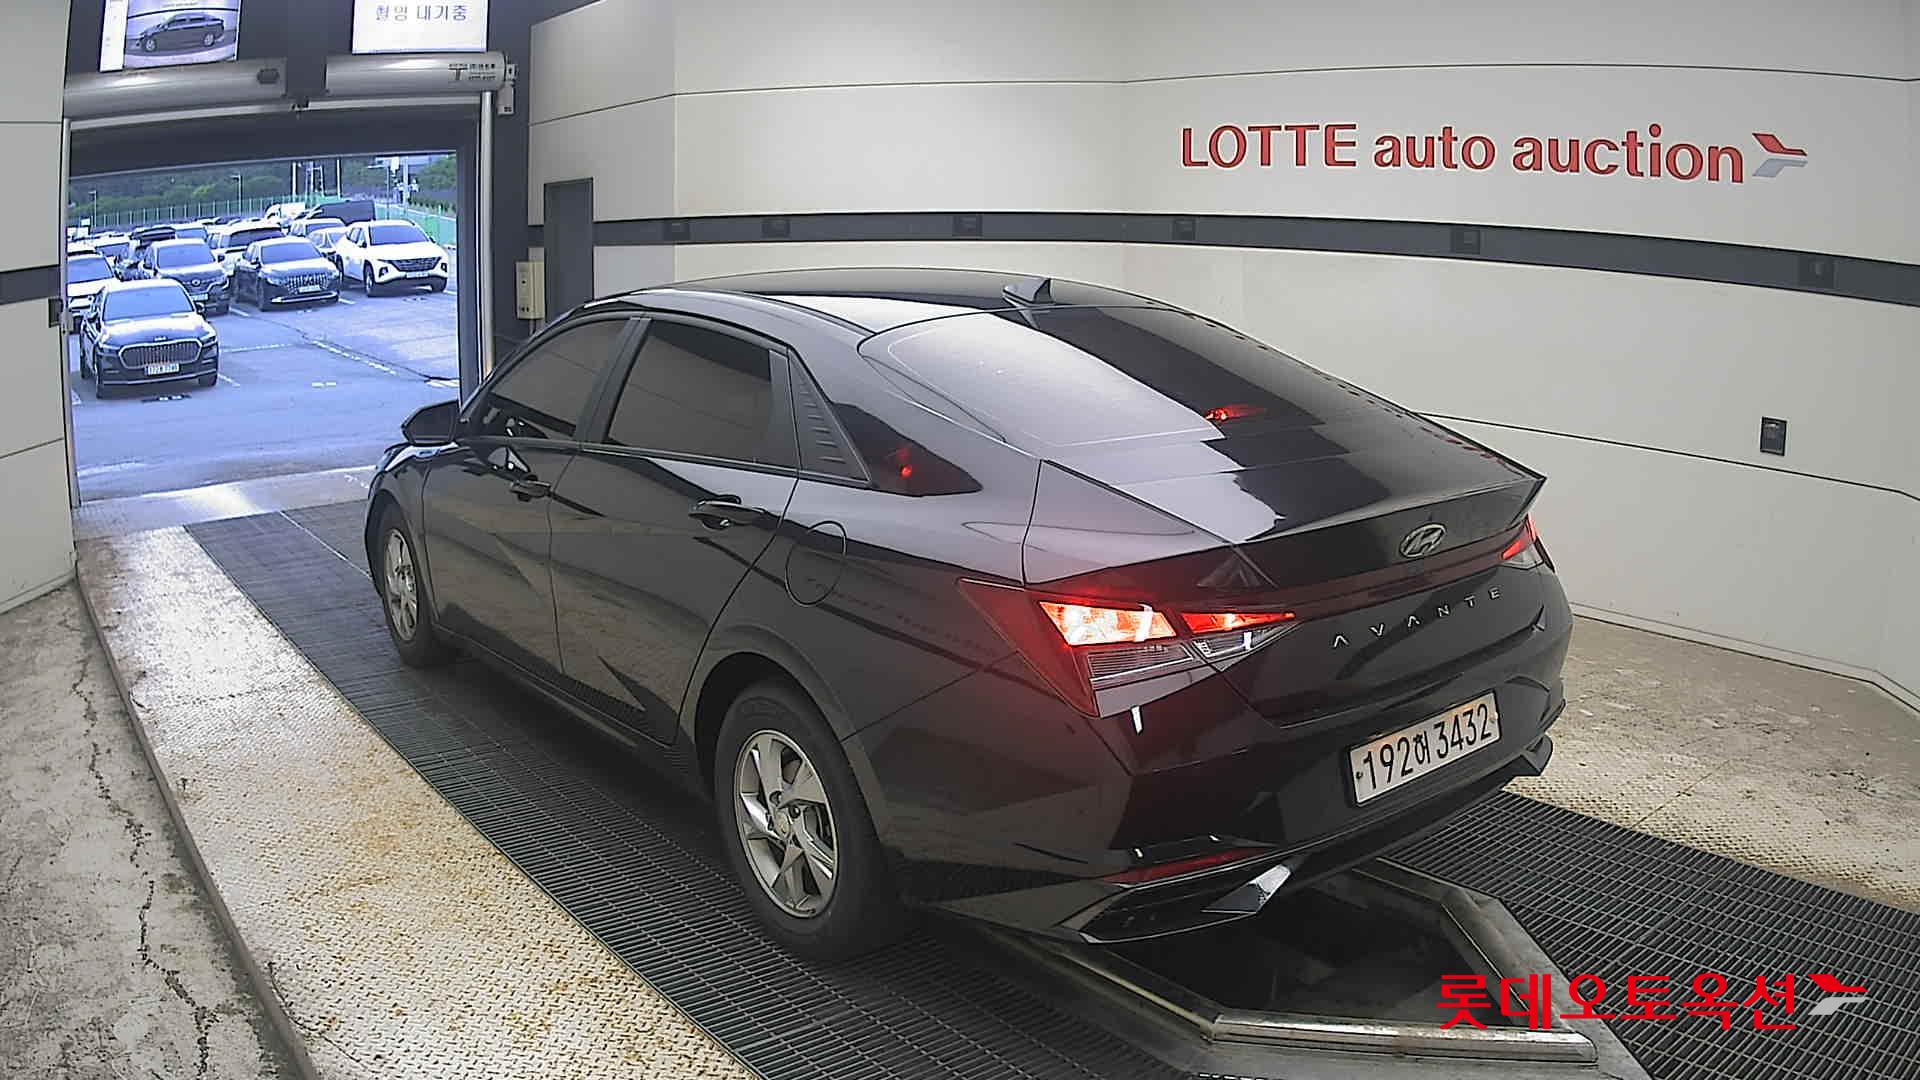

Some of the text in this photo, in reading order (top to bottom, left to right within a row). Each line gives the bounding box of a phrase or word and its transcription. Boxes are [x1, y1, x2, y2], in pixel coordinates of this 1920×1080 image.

[1181, 123, 1745, 184] LOTTE auto auction
[1332, 587, 1502, 649] AVANTE
[1433, 703, 1492, 760] 3432
